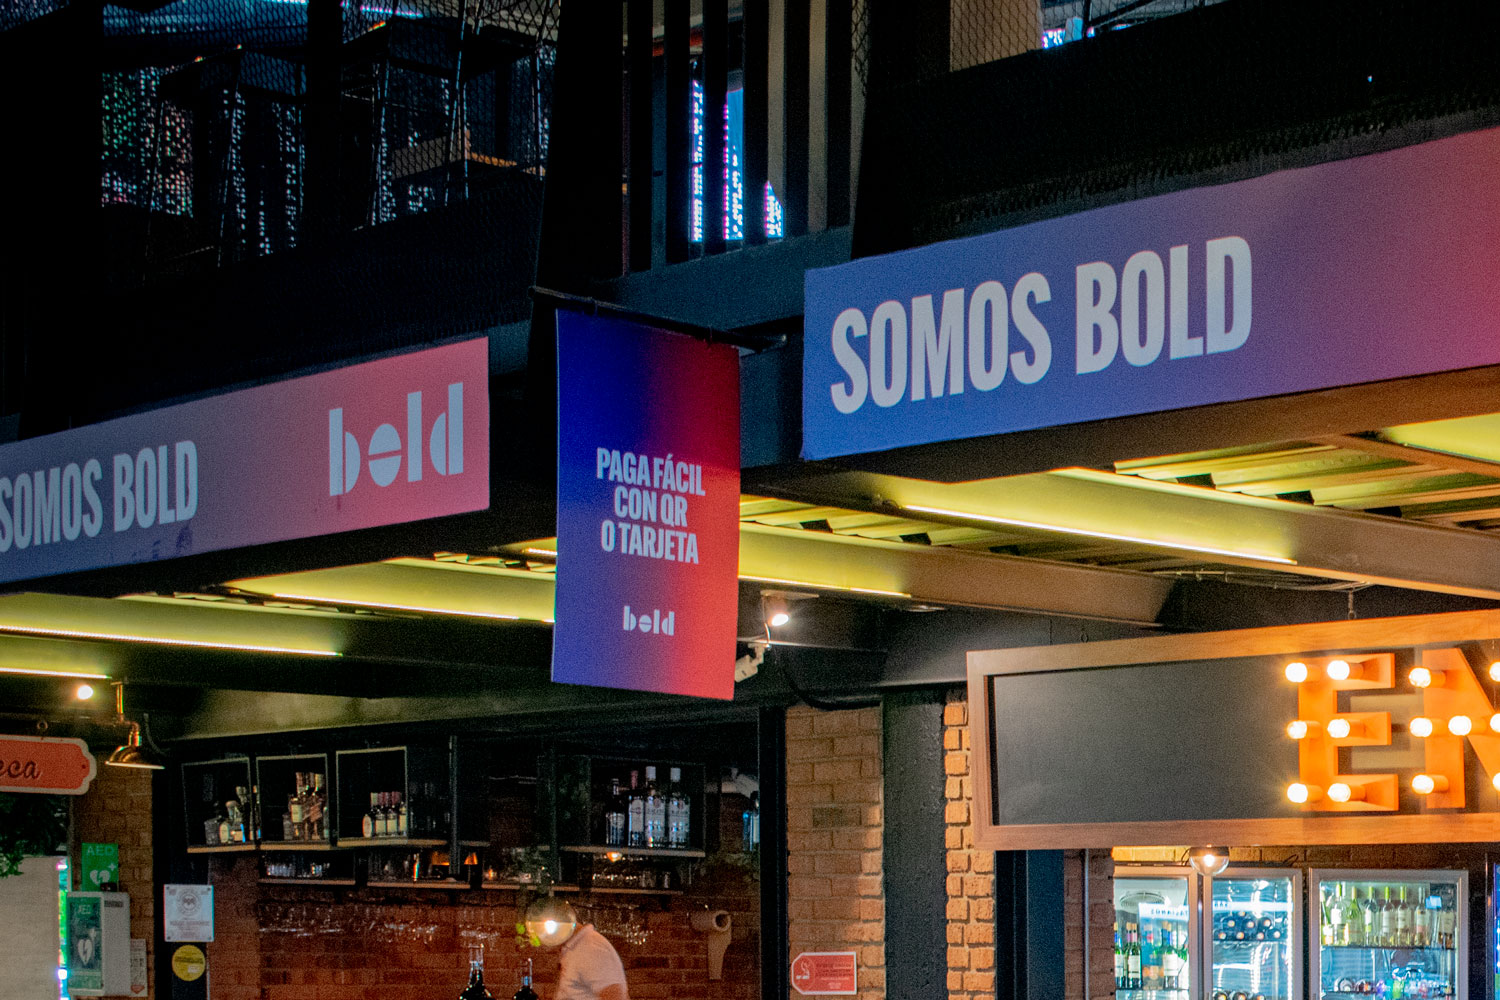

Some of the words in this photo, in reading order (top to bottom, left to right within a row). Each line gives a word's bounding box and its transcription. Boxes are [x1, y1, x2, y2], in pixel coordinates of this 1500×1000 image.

[830, 271, 1053, 415] SOMOS
[1075, 235, 1253, 376] BOLD
[329, 381, 464, 497] bold
[596, 446, 651, 488] PAGA
[653, 453, 707, 497] FÁCIL
[0, 457, 104, 554] SOMOS
[113, 439, 199, 533] BOLD
[614, 485, 658, 523] CON
[660, 493, 688, 528] QR
[601, 518, 616, 553] O
[618, 521, 699, 565] TARJETA
[622, 605, 675, 636] bold
[86, 845, 114, 856] AED
